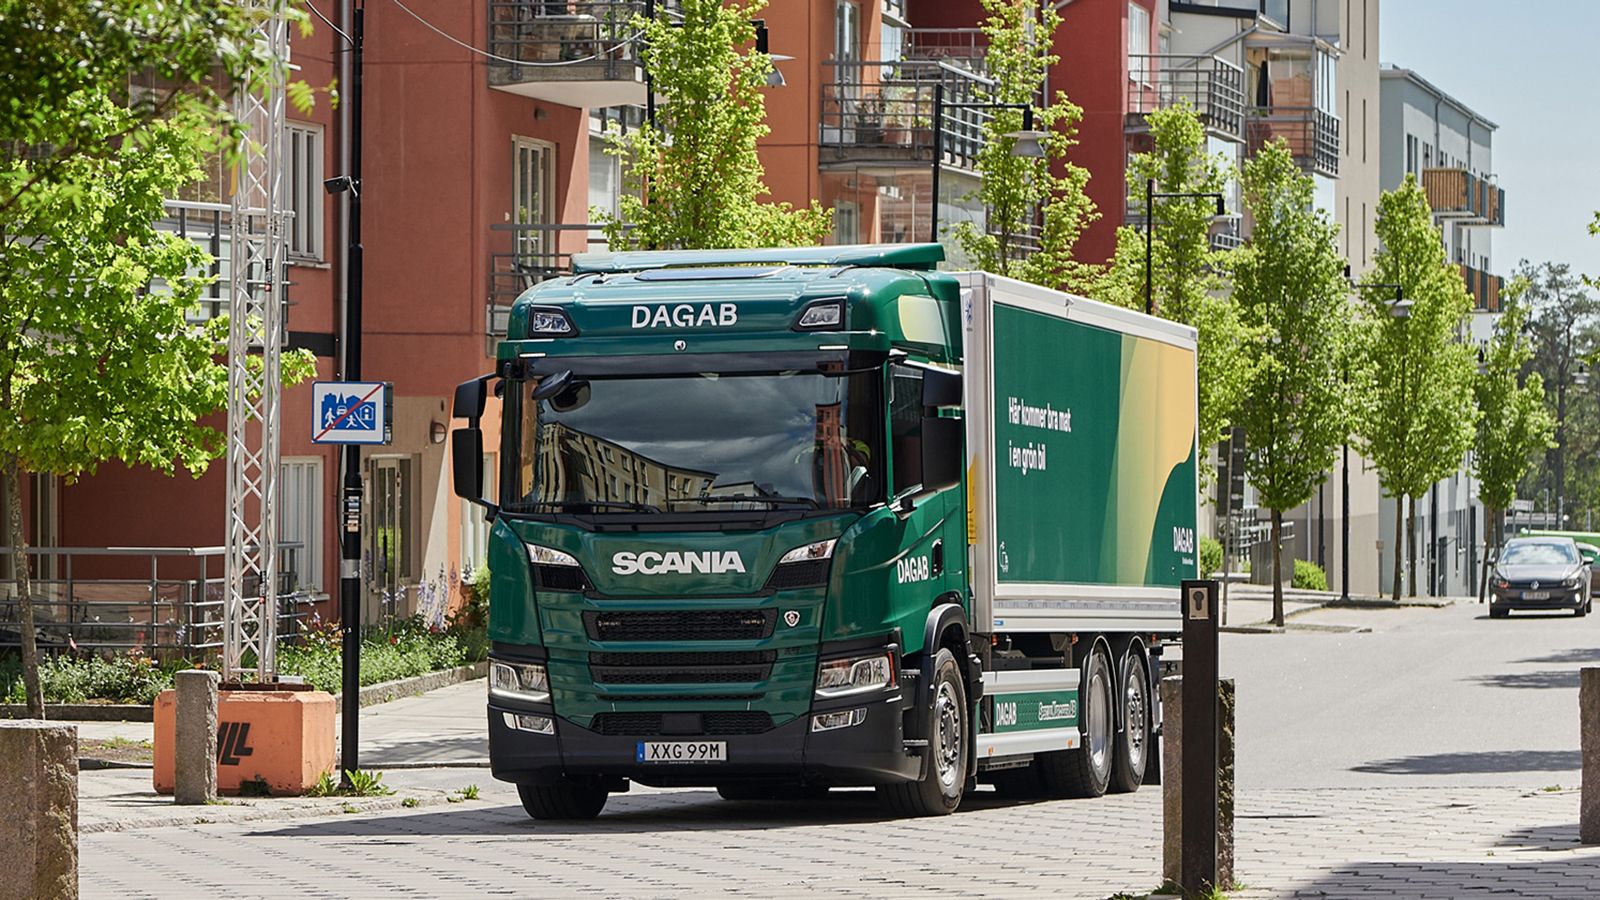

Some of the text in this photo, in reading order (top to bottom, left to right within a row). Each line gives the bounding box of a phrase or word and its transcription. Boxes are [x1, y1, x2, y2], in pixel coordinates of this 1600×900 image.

[632, 303, 738, 328] DAGAB
[1008, 396, 1071, 433] Här kommer bra mat
[1013, 446, 1021, 468] en
[1022, 441, 1037, 476] grön
[1038, 443, 1046, 470] bil
[1173, 526, 1194, 554] DAGAB
[612, 551, 746, 575] SCANIA
[897, 555, 929, 584] DAGAB
[996, 701, 1017, 726] DAGAB
[651, 744, 720, 759] XXG 99M
